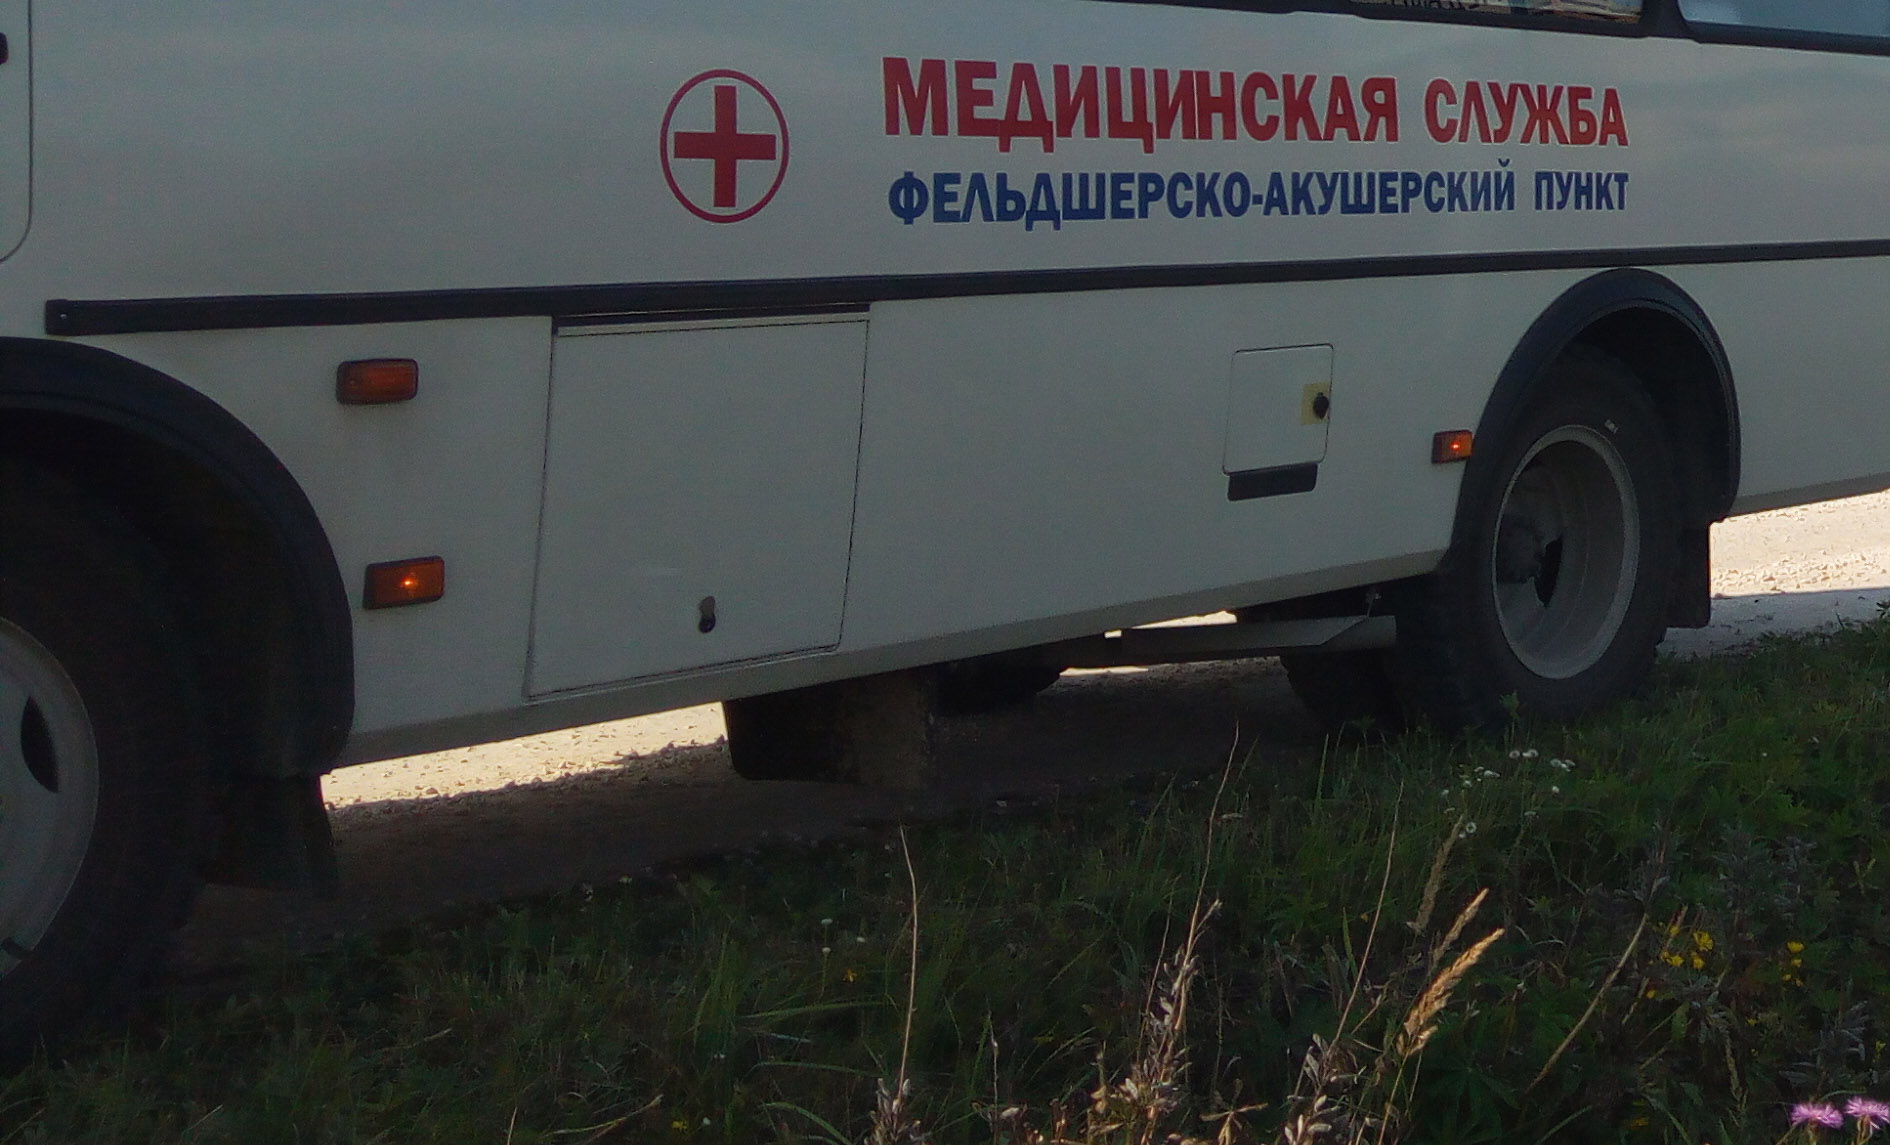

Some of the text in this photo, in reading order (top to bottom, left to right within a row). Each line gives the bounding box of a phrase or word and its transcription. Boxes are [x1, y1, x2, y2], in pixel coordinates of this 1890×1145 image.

[881, 56, 1629, 154] МЕДИЦИНСКАЯ СЛУЖБА
[887, 158, 1630, 232] ФЕЛЬДШЕРСКО-АКУШЕРСКИЙ ПУНКТ
